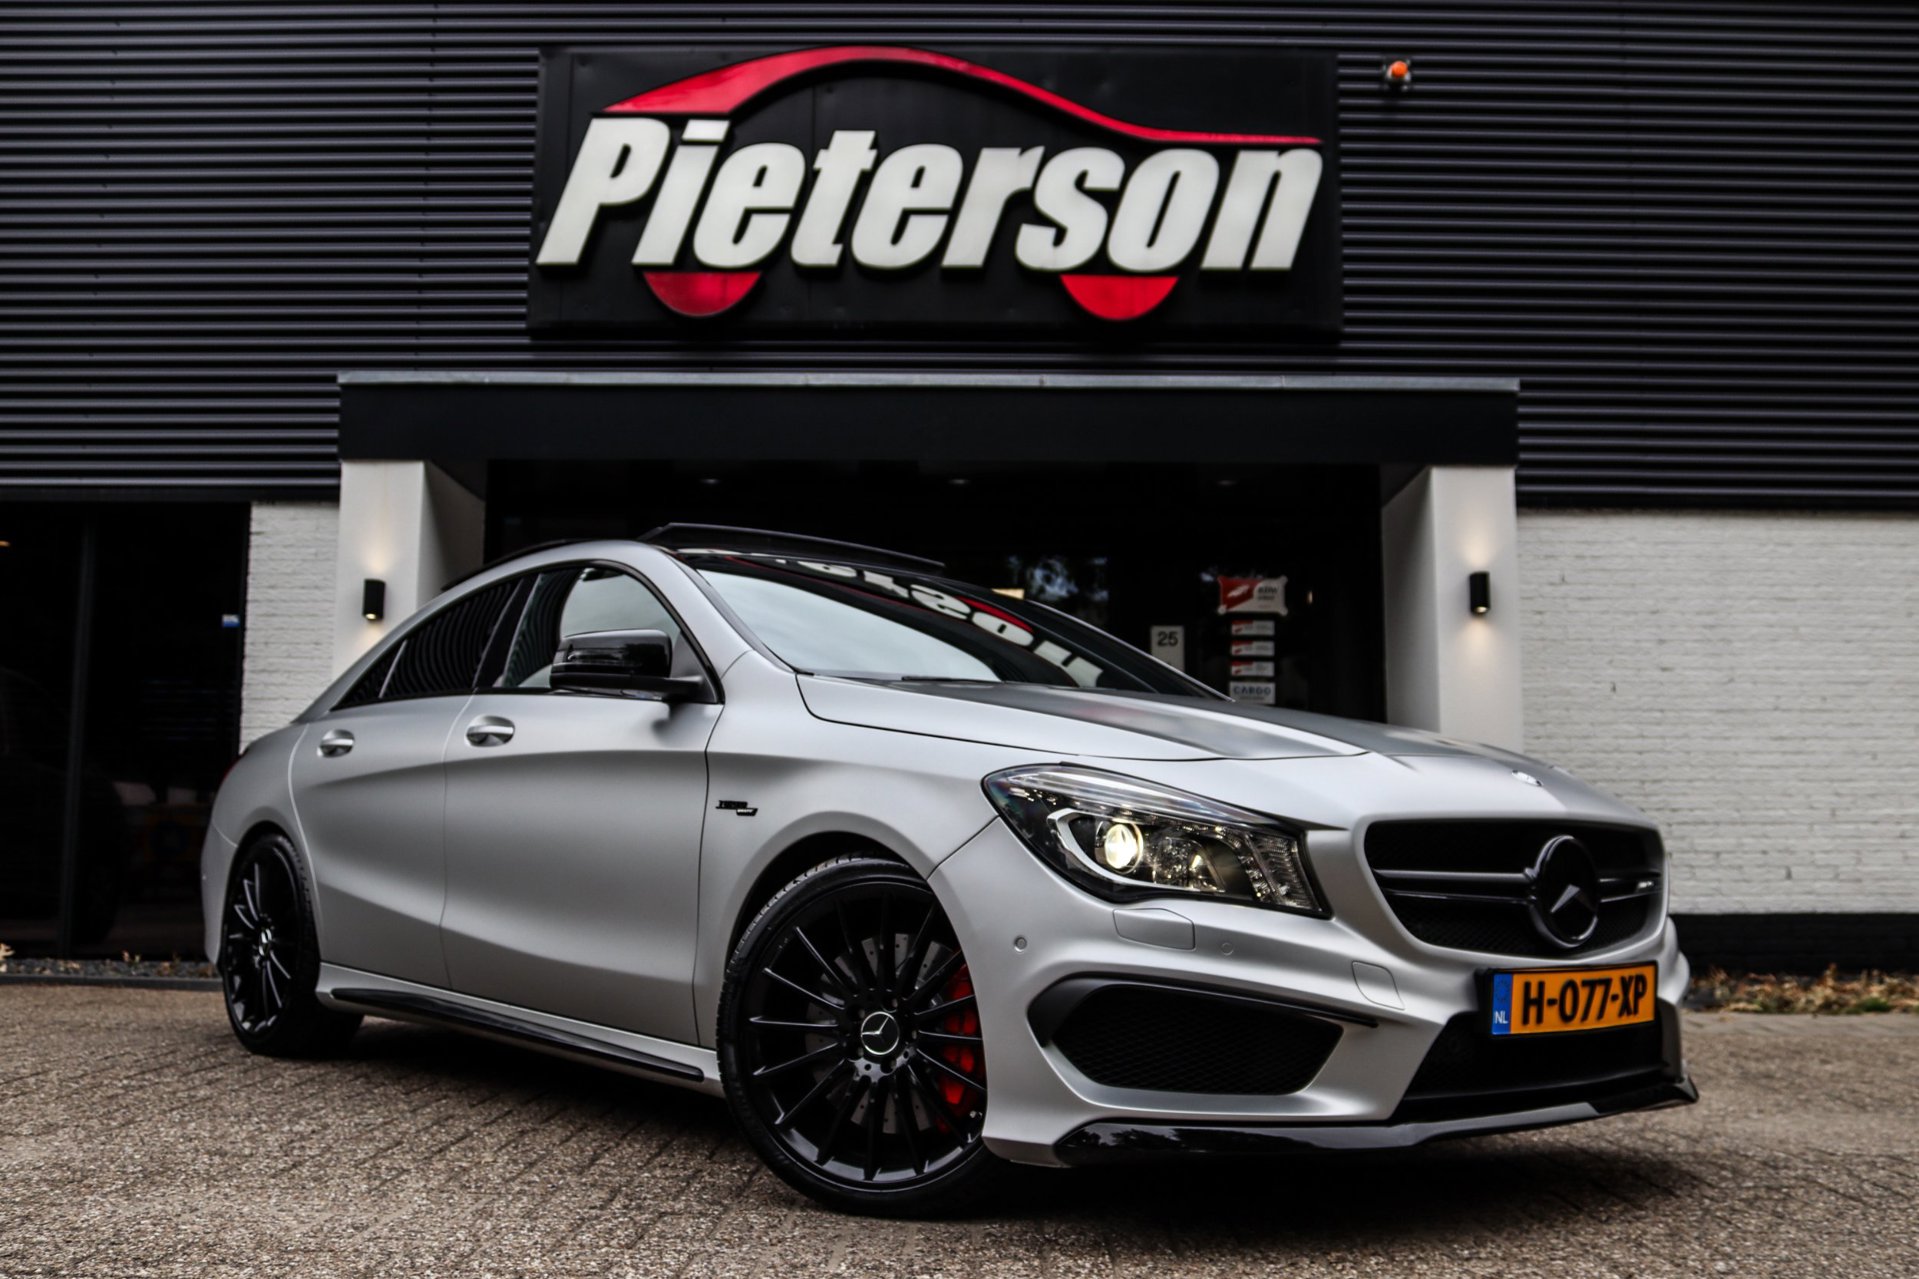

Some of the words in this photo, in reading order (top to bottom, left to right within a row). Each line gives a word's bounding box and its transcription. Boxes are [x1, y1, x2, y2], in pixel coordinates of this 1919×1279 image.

[536, 117, 1322, 271] Pieterson
[1156, 630, 1179, 647] 25
[1232, 685, 1272, 697] CARGO
[1521, 973, 1648, 1026] H-077-XP
[1494, 1010, 1509, 1025] NL
